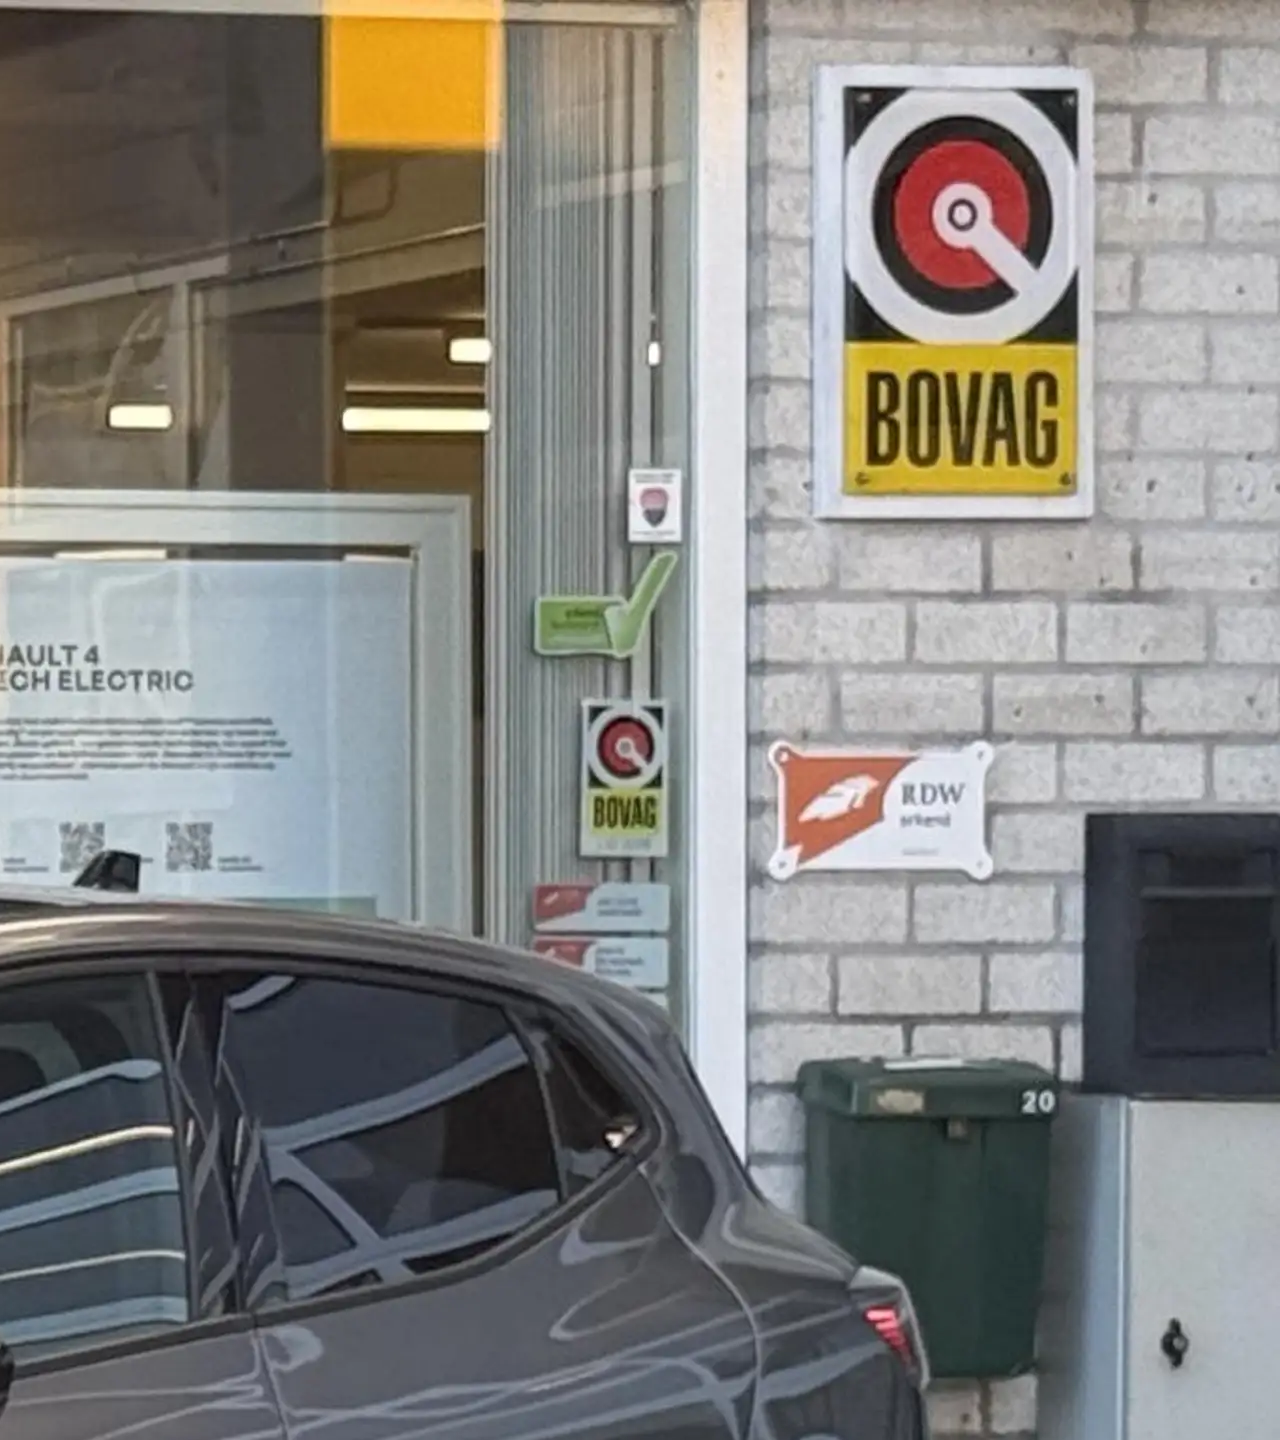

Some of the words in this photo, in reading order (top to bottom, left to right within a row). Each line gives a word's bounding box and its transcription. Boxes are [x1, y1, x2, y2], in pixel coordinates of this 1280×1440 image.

[866, 370, 1058, 468] BOVAG
[84, 645, 100, 667] 4
[59, 669, 194, 692] ELECTRIC
[901, 782, 966, 806] RDW
[593, 795, 658, 829] BOVAG
[1021, 1089, 1056, 1114] 20
